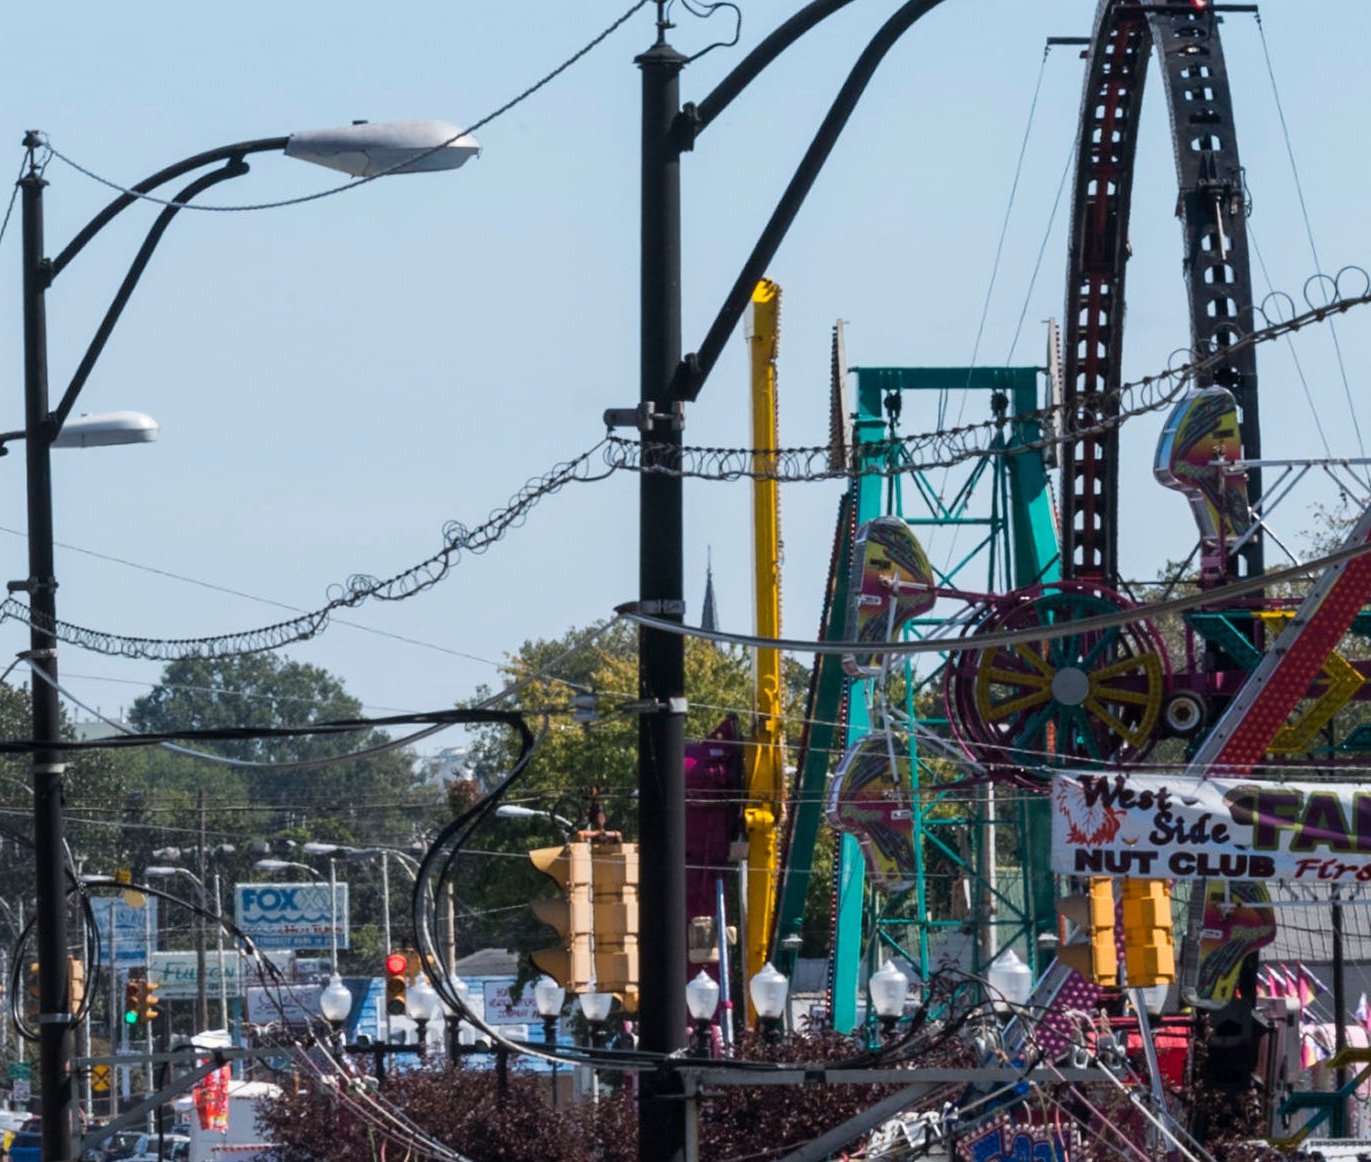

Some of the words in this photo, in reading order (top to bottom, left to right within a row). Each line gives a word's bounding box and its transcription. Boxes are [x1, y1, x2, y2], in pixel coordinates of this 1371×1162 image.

[1077, 774, 1172, 812] West
[1149, 807, 1230, 847] Side
[1075, 848, 1159, 875] NUT
[1168, 851, 1276, 879] CLUB
